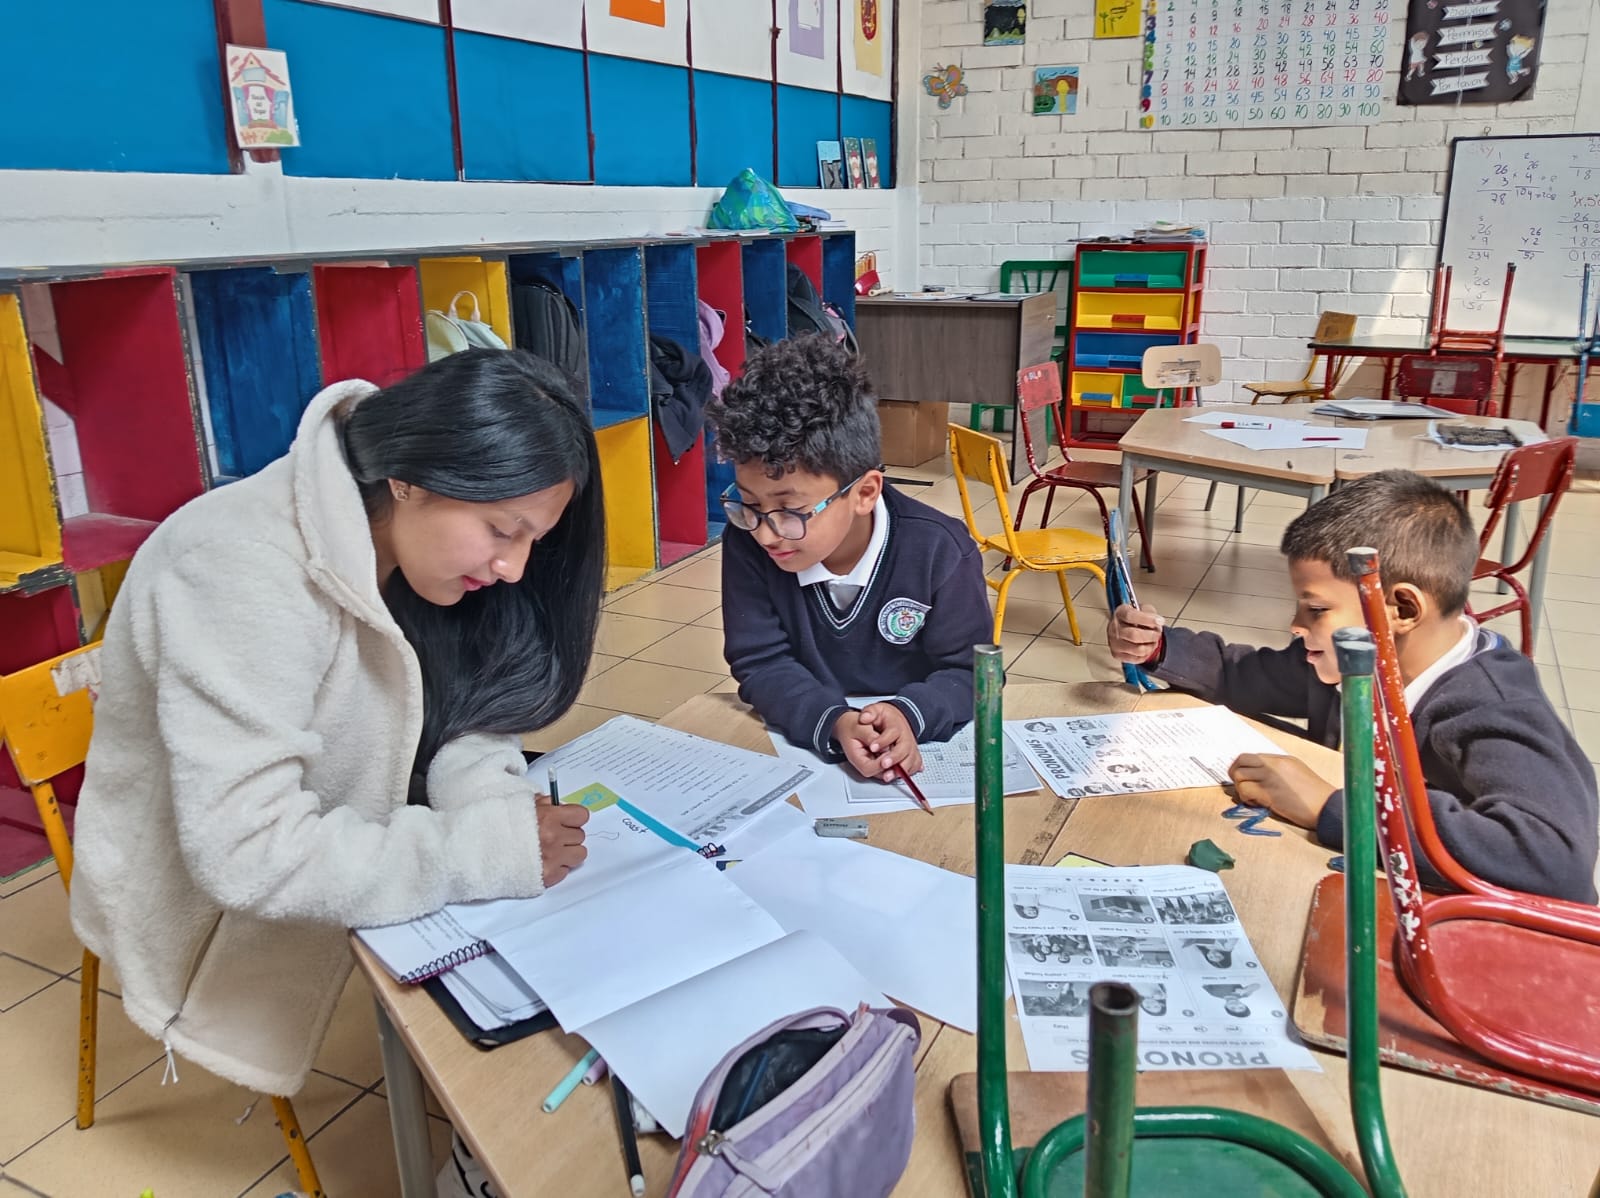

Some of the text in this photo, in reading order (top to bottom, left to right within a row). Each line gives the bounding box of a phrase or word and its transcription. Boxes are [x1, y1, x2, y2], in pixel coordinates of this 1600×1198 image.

[1167, 2, 1175, 11] 2
[1146, 16, 1156, 31] 3
[1168, 16, 1174, 27] 3
[1190, 12, 1196, 24] 6
[1212, 10, 1218, 21] 9
[1233, 7, 1243, 17] 12
[1259, 5, 1269, 15] 15
[1281, 3, 1291, 14] 18
[1304, 2, 1315, 13] 21
[1325, 0, 1336, 11] 24
[1146, 29, 1156, 43] 4
[1190, 26, 1196, 38] 8
[1209, 24, 1218, 36] 12
[1233, 22, 1241, 33] 16
[1256, 17, 1269, 30] 20
[1278, 15, 1290, 28] 24
[1302, 14, 1315, 27] 28
[1325, 13, 1336, 26] 32
[1348, 13, 1358, 25] 36
[1374, 12, 1388, 25] 40
[1166, 43, 1172, 54] 5
[1187, 42, 1197, 53] 10
[1208, 40, 1217, 52] 15
[1229, 37, 1240, 48] 20
[1253, 33, 1267, 46] 25
[1277, 31, 1289, 45] 30
[1300, 30, 1312, 43] 35
[1323, 30, 1336, 42] 40
[1346, 28, 1360, 40] 45
[1373, 26, 1387, 38] 50
[1163, 56, 1169, 67] 6
[1184, 55, 1197, 66] 12
[1206, 53, 1217, 64] 18
[1227, 50, 1239, 63] 24
[1253, 48, 1266, 60] 30
[1276, 46, 1288, 59] 36
[1299, 44, 1312, 60] 42
[1323, 44, 1335, 57] 48
[1344, 42, 1358, 55] 54
[1370, 39, 1384, 54] 60
[1144, 54, 1384, 84] 7 7 14 21 28 35 42 49 56 63 70
[1161, 82, 1168, 96] 8
[1184, 81, 1194, 94] 16
[1203, 79, 1217, 92] 24
[1227, 79, 1240, 90] 32
[1252, 76, 1264, 88] 40
[1273, 74, 1288, 87] 48
[1298, 73, 1311, 84] 56
[1320, 71, 1334, 84] 64
[1344, 69, 1356, 82] 72
[1367, 69, 1384, 83] 80
[1141, 85, 1380, 112] 9 9 18 27 36 45 54 63 72 81 90
[1160, 115, 1171, 126] 10
[1181, 112, 1197, 125] 20
[1203, 110, 1218, 123] 30
[1225, 108, 1239, 121] 40
[1248, 107, 1263, 120] 50
[1271, 106, 1286, 120] 60
[1295, 104, 1308, 119] 70
[1317, 104, 1333, 119] 80
[1339, 103, 1351, 117] 90
[1358, 103, 1380, 117] 100
[1493, 164, 1508, 175] 26
[1501, 176, 1509, 187] 3
[1525, 172, 1532, 184] 4
[1491, 192, 1507, 206] 78
[1573, 212, 1589, 222] 26
[1477, 223, 1493, 235] 26
[1530, 227, 1542, 236] 26
[1481, 236, 1489, 246] 9
[1532, 237, 1539, 246] 2
[1468, 251, 1490, 261] 234
[1473, 277, 1491, 286] 26
[1025, 739, 1070, 780] PRONOUNS
[1071, 1050, 1270, 1067] PRONOS
